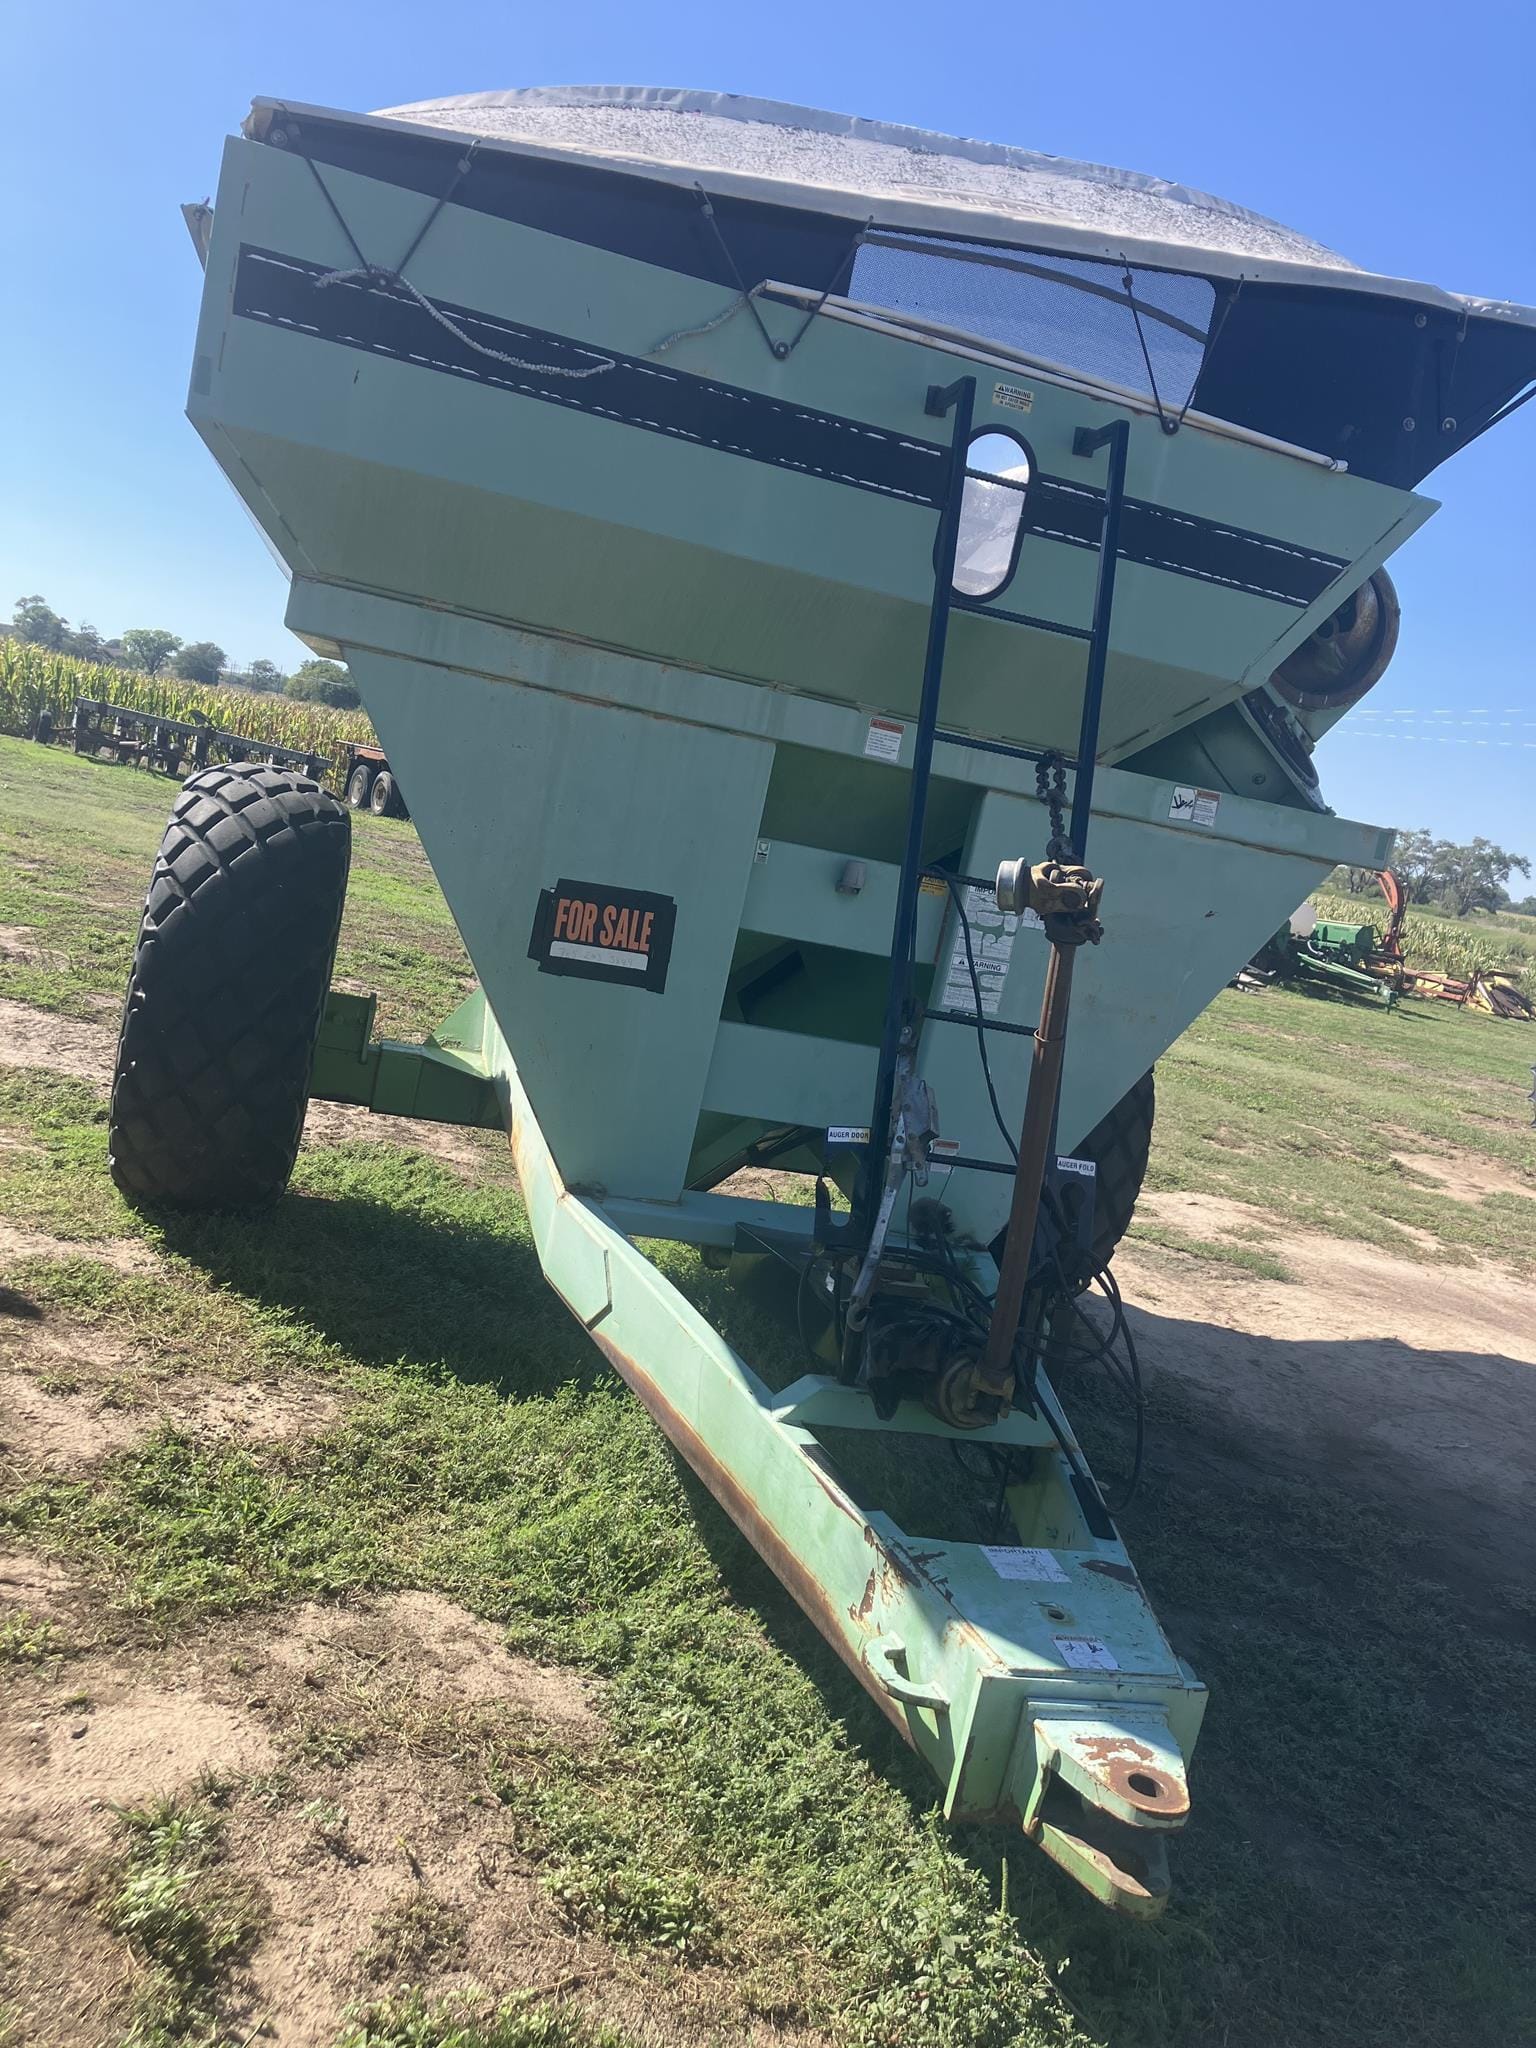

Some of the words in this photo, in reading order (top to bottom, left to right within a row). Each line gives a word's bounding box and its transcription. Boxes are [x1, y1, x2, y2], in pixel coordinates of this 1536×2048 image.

[1005, 386, 1031, 399] WARNING
[553, 898, 598, 943] FOR
[600, 905, 655, 951] SALE
[972, 960, 1001, 971] ARNING
[851, 1131, 869, 1139] DOOR
[1058, 1160, 1078, 1169] AUGER
[1078, 1163, 1095, 1171] FOLD
